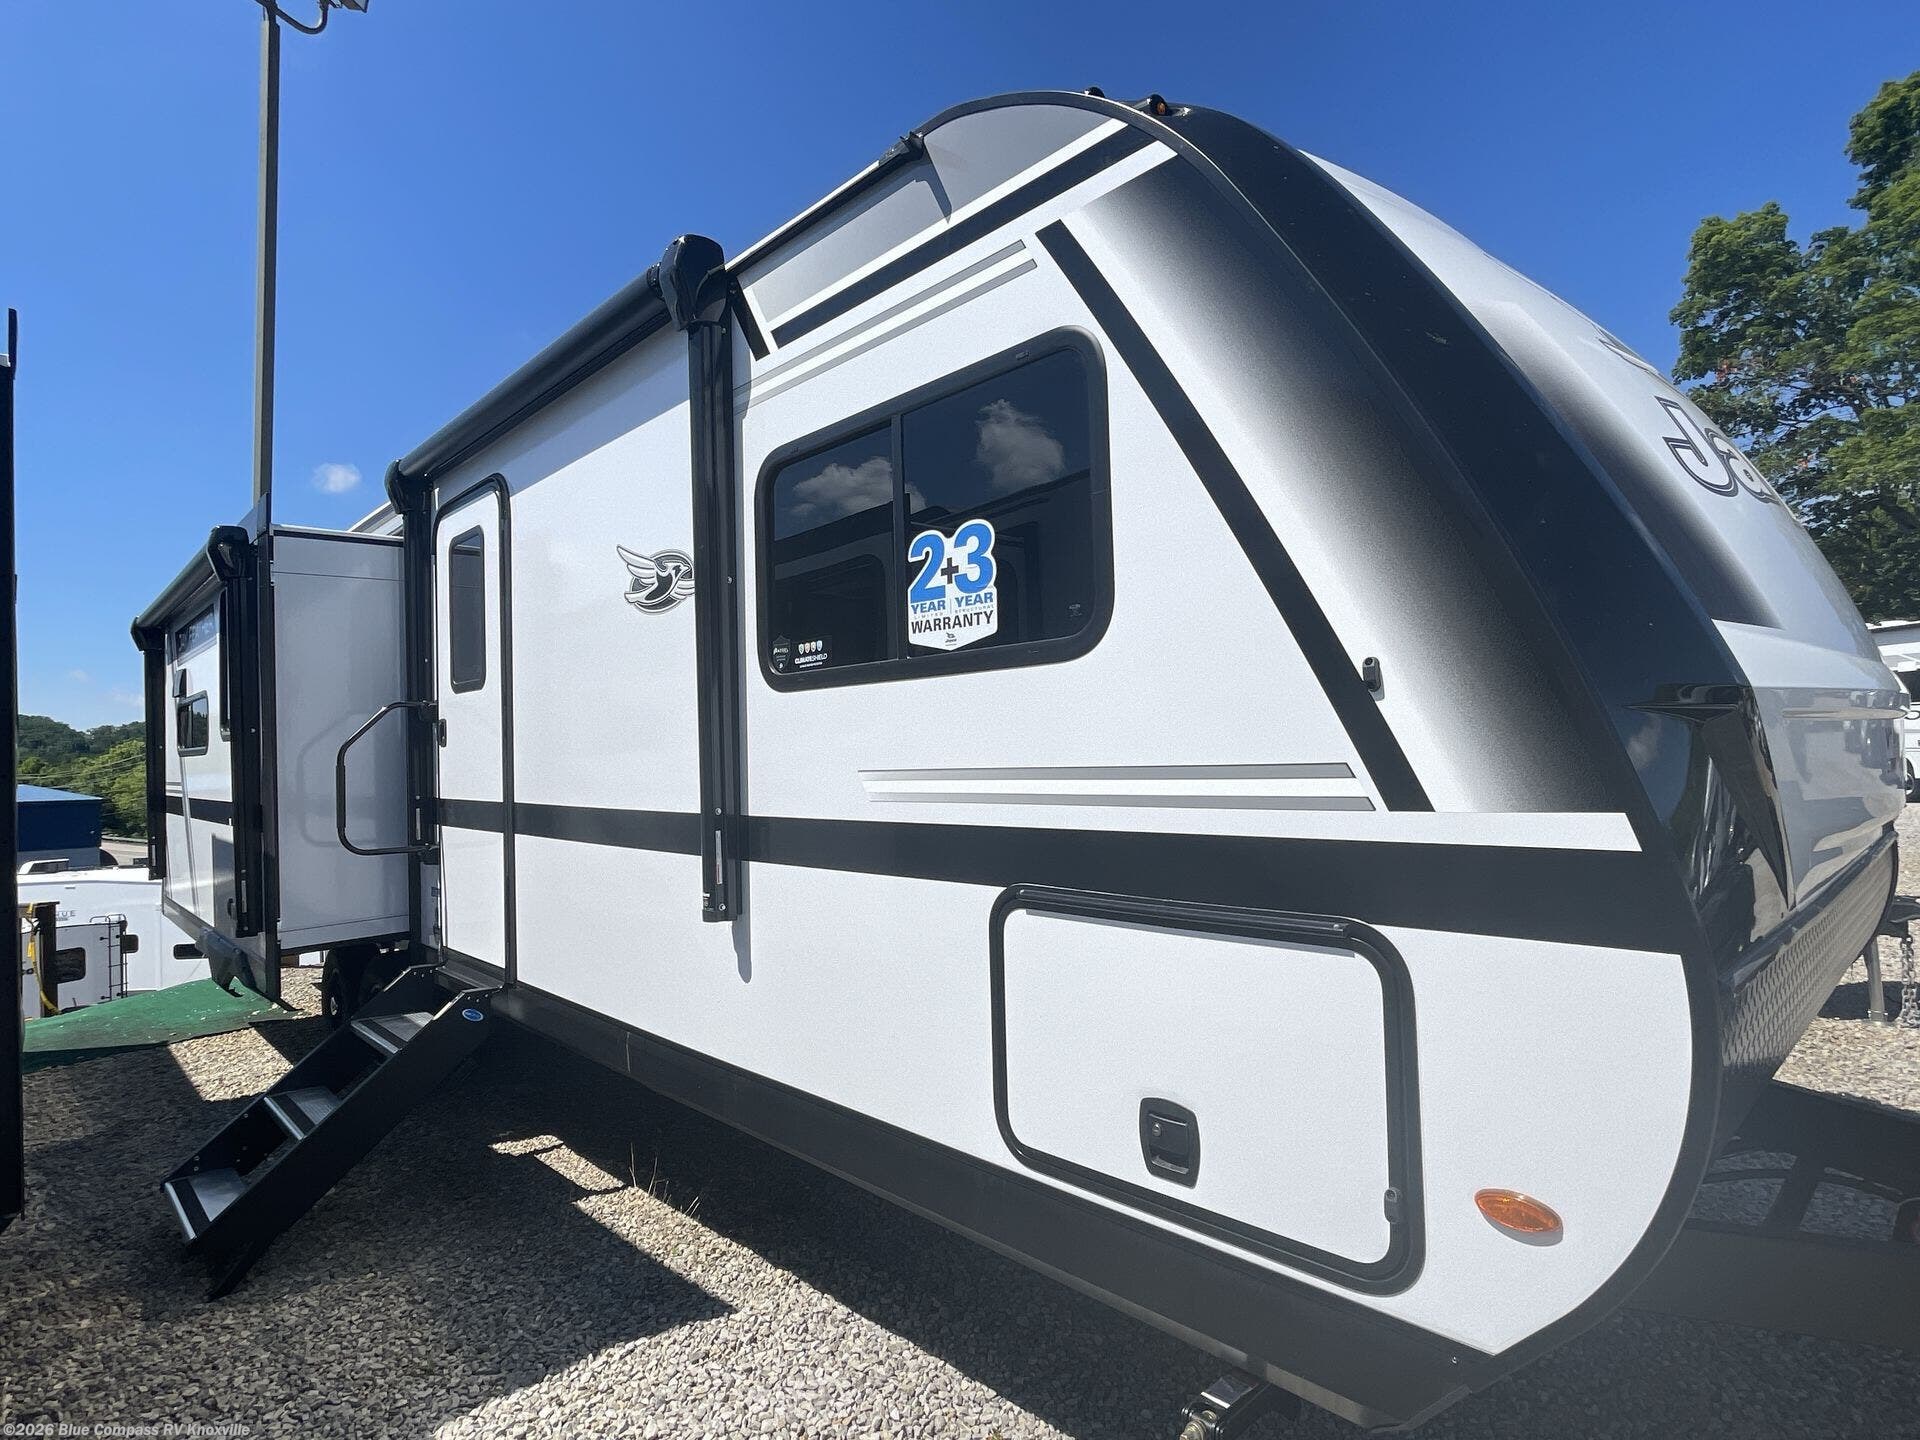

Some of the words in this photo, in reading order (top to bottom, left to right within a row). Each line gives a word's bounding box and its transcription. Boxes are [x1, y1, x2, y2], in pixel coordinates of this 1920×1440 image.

[911, 600, 946, 614] YEAR
[955, 592, 994, 607] YEAR
[911, 610, 994, 634] WARRANTY
